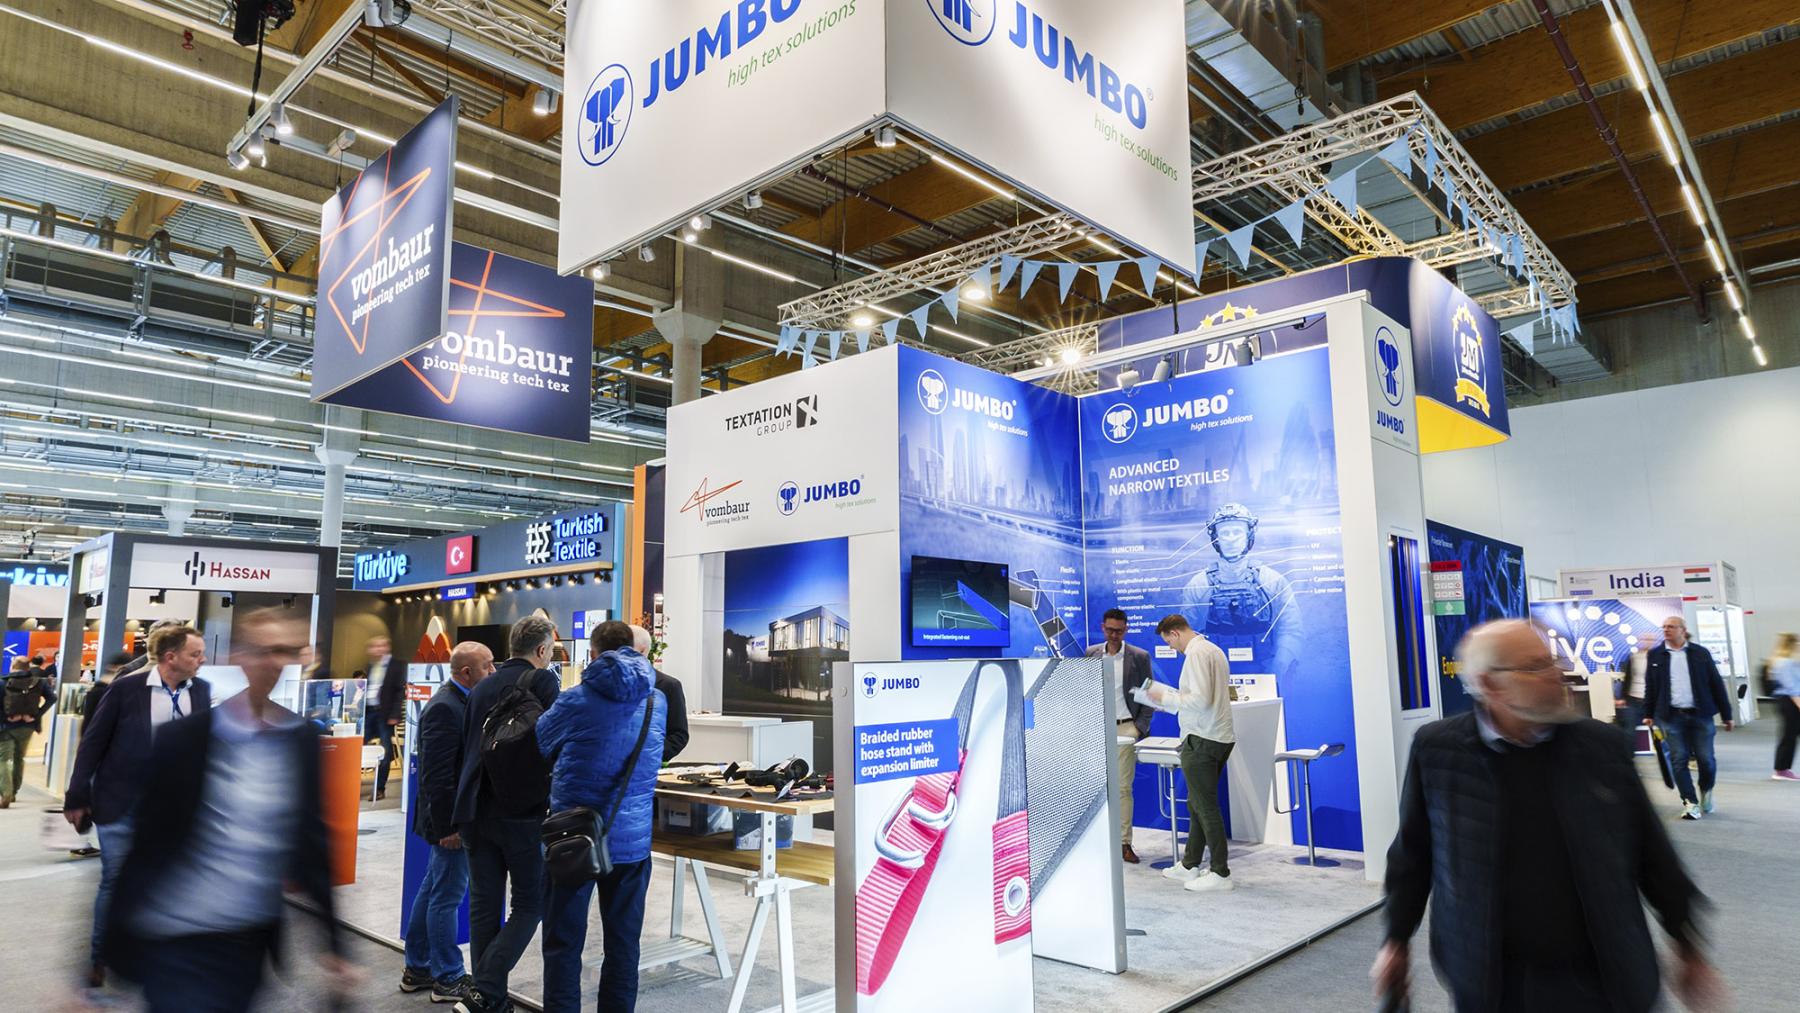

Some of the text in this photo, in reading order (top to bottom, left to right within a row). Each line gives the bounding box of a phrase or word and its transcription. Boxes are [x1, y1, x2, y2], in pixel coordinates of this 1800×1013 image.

[727, 2, 856, 88] high tex solutions
[1009, 1, 1148, 130] JUMBO
[1094, 112, 1178, 181] high tex solutions
[352, 224, 434, 300] vombaur
[352, 264, 430, 325] pioneering tech tex
[426, 330, 573, 377] ombaur
[423, 355, 569, 393] pioneering tech tex
[725, 402, 792, 431] TEXTATION
[952, 388, 1014, 420] JUMBO
[1143, 394, 1229, 427] JUMBO
[757, 420, 792, 436] GROUP
[1190, 414, 1253, 432] high tex solutions
[1376, 409, 1404, 434] JUMBO
[1109, 458, 1180, 480] ADVANCED
[1109, 468, 1230, 496] NARROW TEXTILES
[804, 479, 861, 502] JUMBO
[705, 500, 750, 517] vombaur
[554, 511, 603, 538] Turkish
[1306, 527, 1342, 536] PROTECT
[553, 538, 596, 561] Textile
[357, 551, 407, 583] Türkiye
[1609, 572, 1665, 589] India
[882, 677, 920, 690] JUMBO
[860, 727, 933, 745] Braided rubber
[861, 742, 934, 761] hose stand with
[861, 756, 939, 778] expansion limiter
